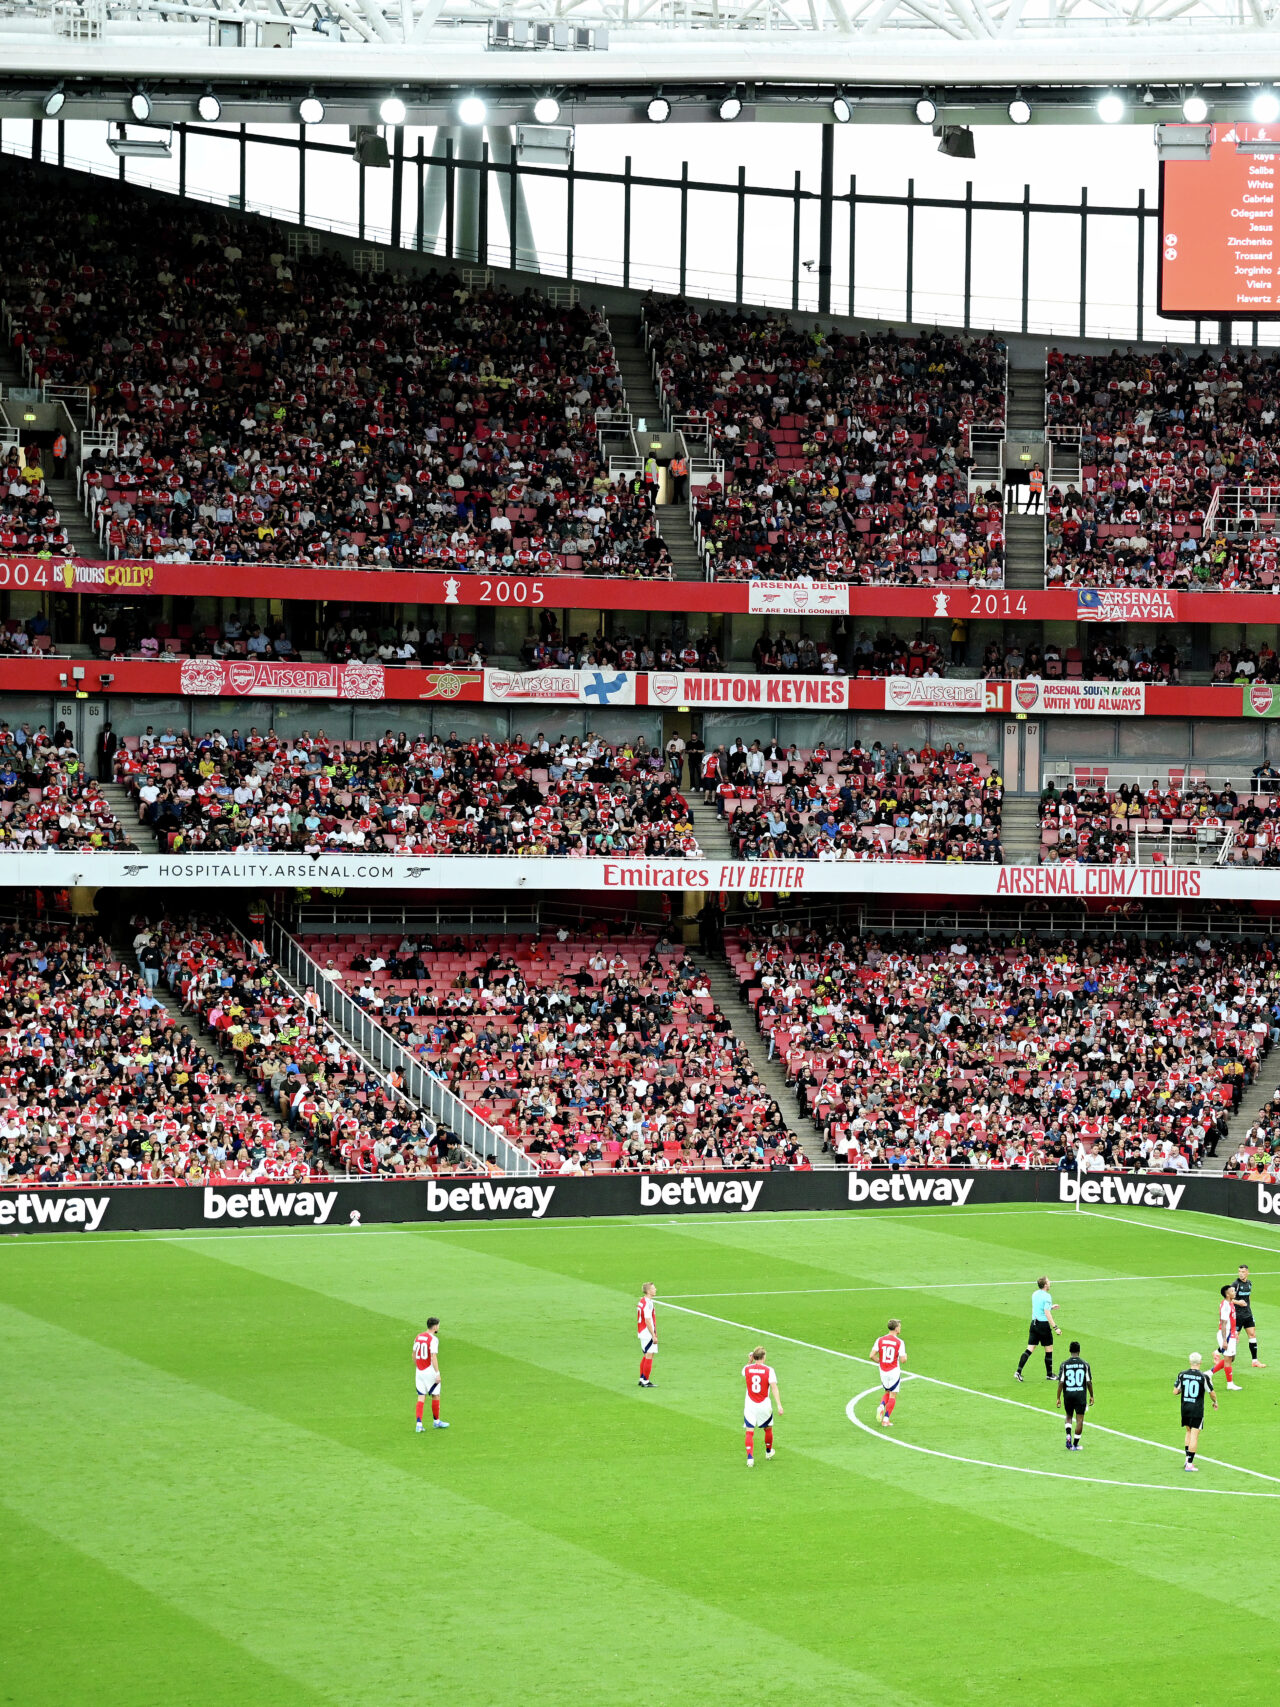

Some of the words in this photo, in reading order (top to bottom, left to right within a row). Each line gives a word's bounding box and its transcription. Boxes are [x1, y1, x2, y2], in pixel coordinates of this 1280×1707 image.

[1253, 154, 1274, 162] Raya
[1249, 166, 1274, 175] Saliba
[1247, 180, 1274, 189] White
[1242, 194, 1274, 203] Gabriel
[1249, 223, 1273, 232] Jesus
[1227, 237, 1273, 246] Zinchenko
[1235, 251, 1273, 260] Trossard
[1234, 265, 1272, 276] Jorginho
[1246, 280, 1272, 289] Vieira
[1237, 294, 1271, 303] Havertz
[0, 563, 48, 587] 004
[53, 565, 63, 581] IS
[75, 566, 105, 583] YOURS
[104, 565, 154, 587] GOLD?
[480, 581, 544, 603] 2005
[751, 581, 808, 590] ARSENAL
[812, 583, 847, 591] DELHI
[970, 594, 1028, 616] 2014
[1103, 591, 1171, 605] ARSENAL
[1097, 605, 1175, 619] MALAYSIA
[255, 665, 338, 688] Arsenal
[509, 672, 580, 692] Arsenal
[683, 677, 761, 703] MILTON
[766, 679, 845, 704] KEYNES
[911, 681, 983, 701] Arsenal
[1043, 685, 1081, 695] ARSENAL
[1083, 685, 1109, 696] SOUTH
[1111, 686, 1141, 697] AFRICA
[61, 705, 72, 716] 65
[89, 706, 99, 717] 65
[1043, 697, 1070, 709] WITH
[1073, 698, 1095, 710] YOU
[1097, 698, 1142, 711] ALWAYS
[1006, 725, 1017, 735] 67
[1027, 725, 1038, 735] 67
[159, 864, 394, 879] HOSPITALITY.ARSENAL.COM
[603, 863, 710, 887] Emirates
[719, 865, 745, 888] FLY
[750, 866, 805, 889] BETTER
[996, 867, 1201, 896] ARSENAL.COM/TOURS
[640, 1176, 763, 1212] betway
[848, 1172, 974, 1206] betway
[1059, 1174, 1186, 1210] betway
[204, 1187, 338, 1224] betway
[426, 1181, 556, 1218] betway
[0, 1193, 110, 1231] etway
[414, 1342, 428, 1360] 20
[882, 1346, 896, 1363] 19
[751, 1375, 762, 1393] 8
[1065, 1369, 1085, 1387] 30
[1182, 1379, 1199, 1397] 10
